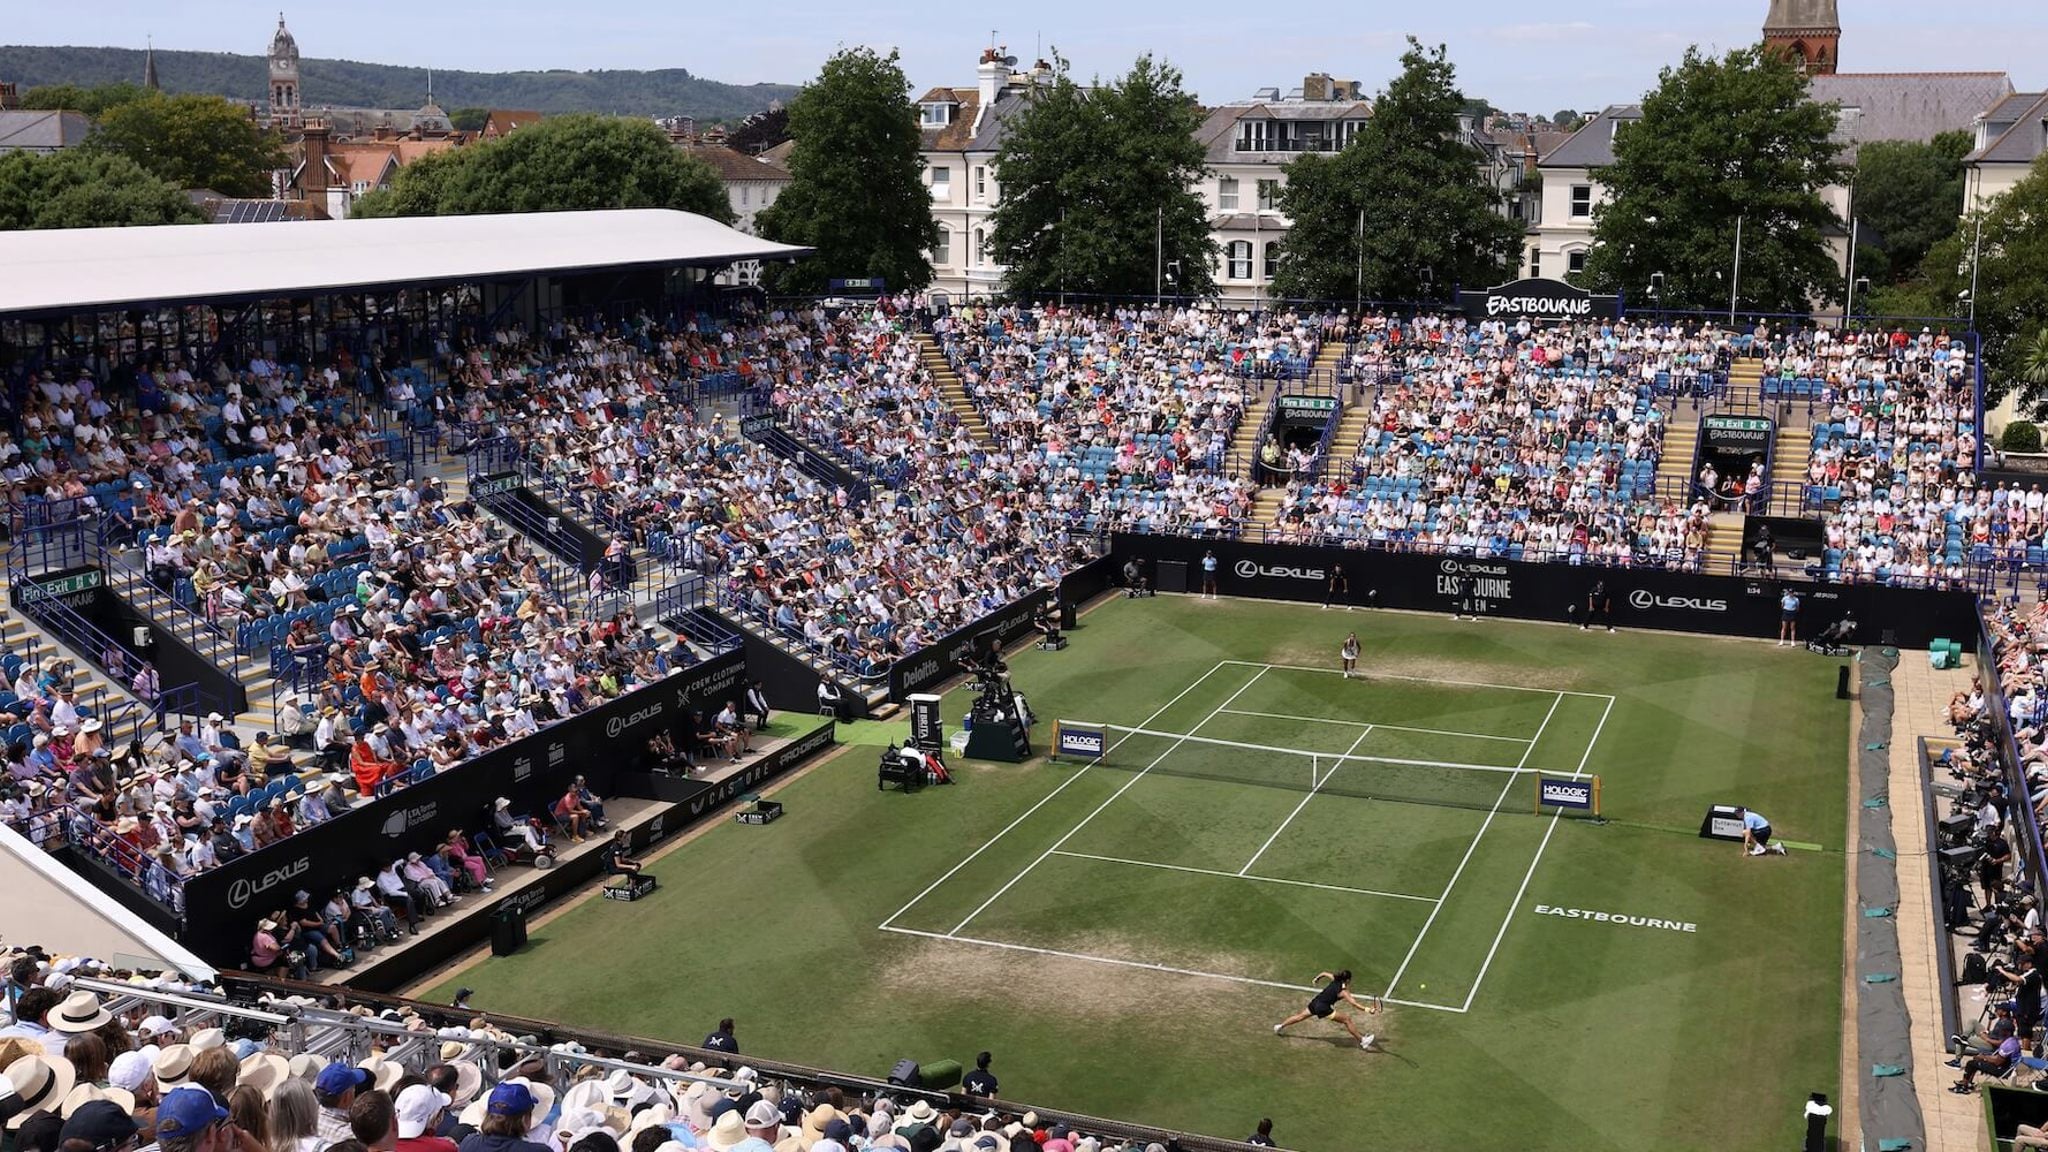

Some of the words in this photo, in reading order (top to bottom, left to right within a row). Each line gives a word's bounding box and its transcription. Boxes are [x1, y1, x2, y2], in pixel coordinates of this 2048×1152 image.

[1486, 295, 1591, 315] EASTBOURNE
[1707, 418, 1724, 427] Fire
[1726, 419, 1744, 428] Exit
[1710, 429, 1765, 440] EASTBOURNE
[1259, 565, 1325, 580] LEXUS
[47, 580, 69, 595] Exit
[1437, 575, 1511, 599] EASOURNE
[1655, 595, 1727, 611] LEXUS
[691, 676, 711, 690] CREW
[712, 661, 746, 681] CLOTHING
[704, 676, 735, 696] COMPANY
[622, 702, 662, 728] LEXUS
[1062, 735, 1101, 745] HOLOGIC
[1543, 785, 1588, 797] HOLOGIC
[252, 857, 309, 894] LEXUS
[1534, 905, 1697, 933] EASTBOURNE
